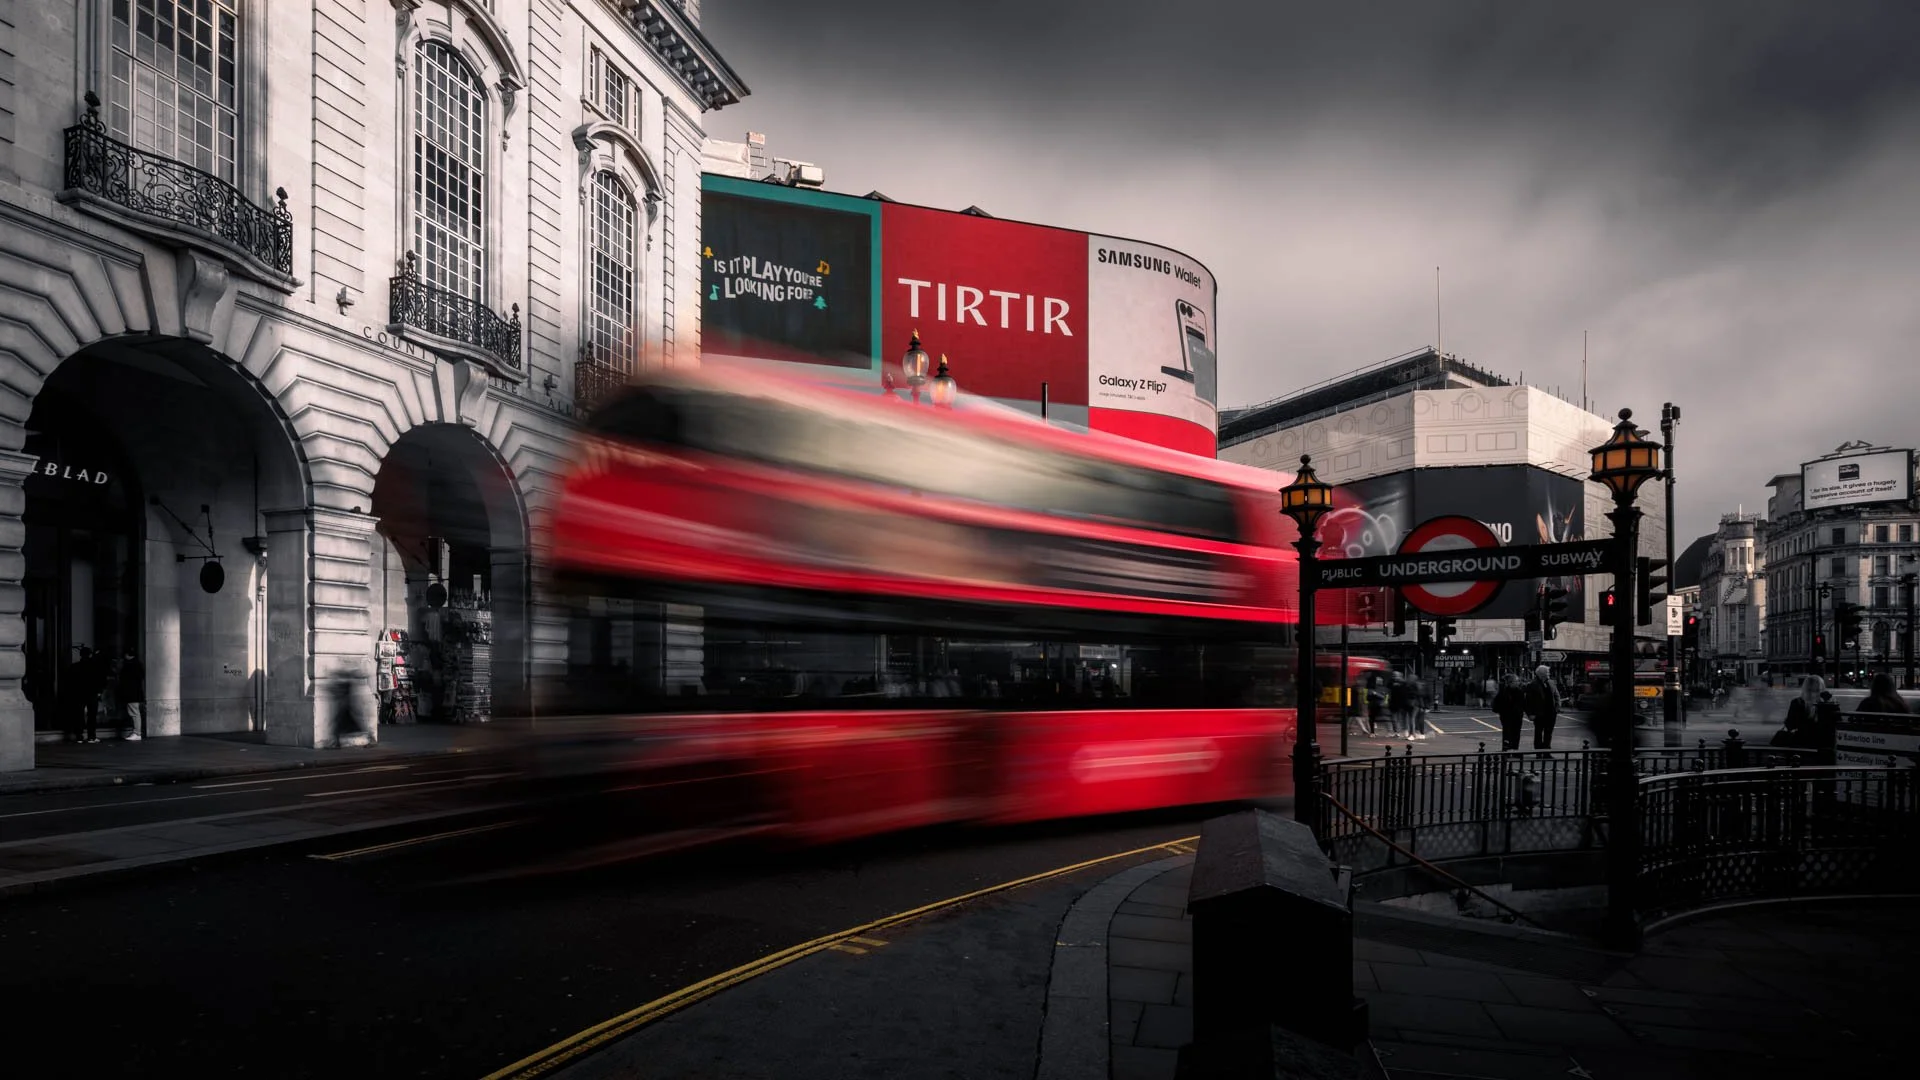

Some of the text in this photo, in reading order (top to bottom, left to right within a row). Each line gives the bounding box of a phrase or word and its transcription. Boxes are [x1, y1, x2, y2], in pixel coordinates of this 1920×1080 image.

[713, 255, 823, 288] IS IT PLAY YOU'RE
[1097, 248, 1201, 289] SAMSUNG Wallet
[724, 277, 785, 302] LOOKING
[898, 277, 1074, 337] TIRTIR
[1098, 374, 1167, 395] Galaxy Z Flip7
[1838, 487, 1866, 496] account
[1873, 479, 1897, 488] hugely
[1321, 550, 1604, 581] PUBLIC UNDERGROUND SUBWAY
[1872, 735, 1886, 745] line
